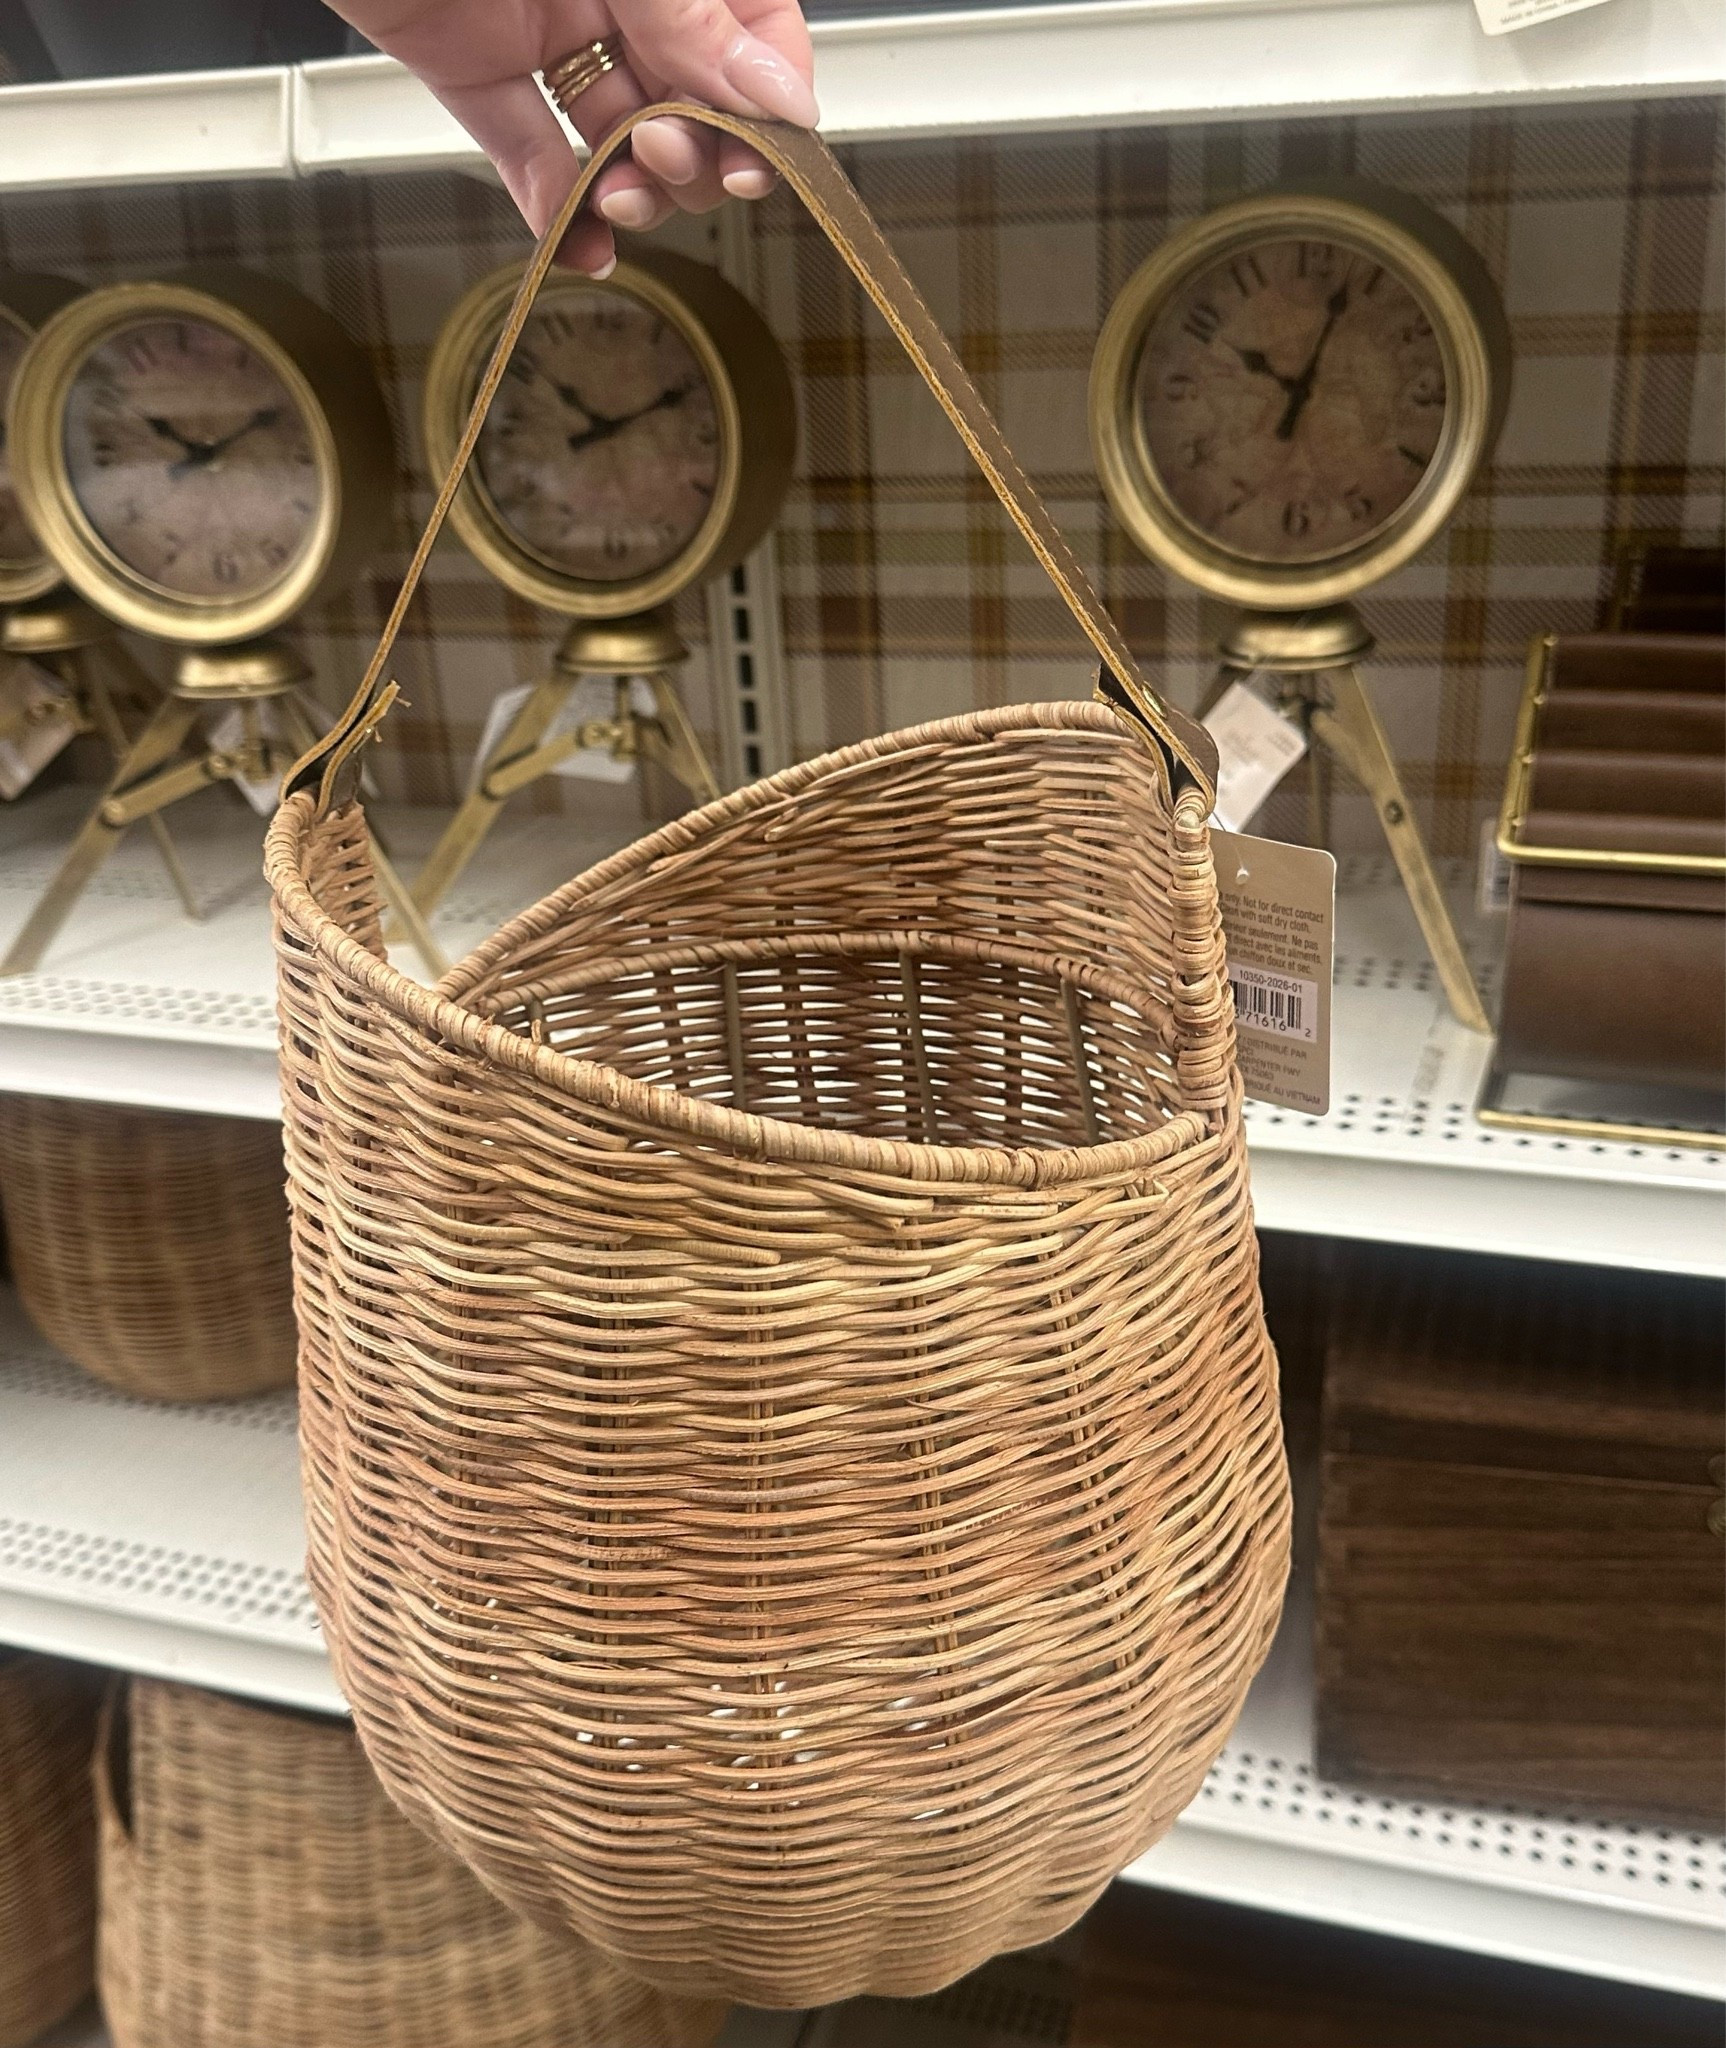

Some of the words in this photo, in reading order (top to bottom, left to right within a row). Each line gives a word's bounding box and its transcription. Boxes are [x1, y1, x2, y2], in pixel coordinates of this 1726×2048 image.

[1241, 909, 1256, 920] with
[1258, 913, 1272, 925] soft
[1274, 916, 1288, 930] dry
[1290, 920, 1311, 933] cloth.
[1244, 896, 1256, 909] Not
[1258, 899, 1269, 912] for
[1270, 902, 1294, 916] direct
[1295, 908, 1324, 923] contact
[1234, 934, 1254, 948] direct
[1256, 940, 1273, 954] avec
[1275, 944, 1286, 956] les
[1292, 934, 1302, 947] Ne
[1304, 939, 1319, 951] pas
[1266, 955, 1286, 969] doux
[1288, 960, 1296, 971] et
[1240, 970, 1303, 994] 10350-2026-01
[1246, 1011, 1287, 1032] 71616
[1304, 1028, 1311, 1038] 2
[1286, 1090, 1321, 1104] VIETNAM
